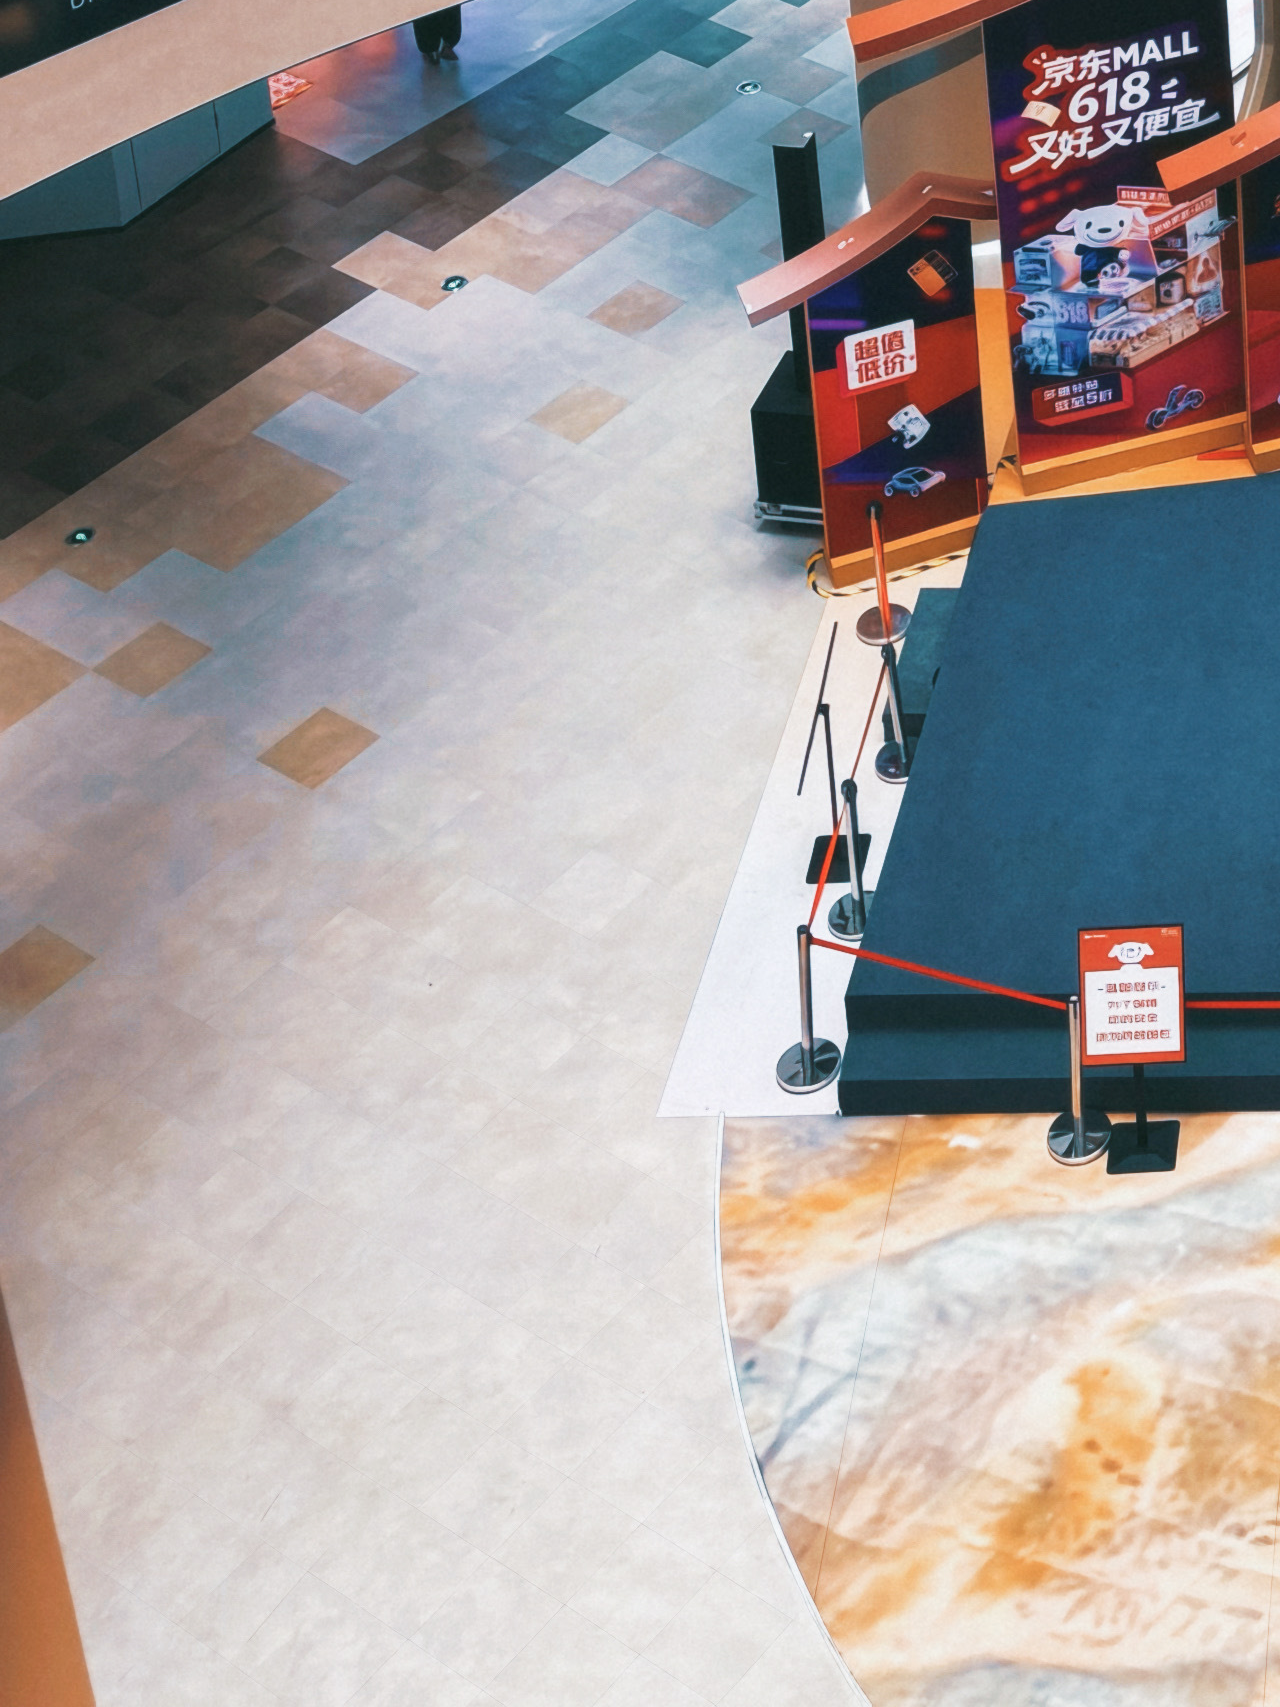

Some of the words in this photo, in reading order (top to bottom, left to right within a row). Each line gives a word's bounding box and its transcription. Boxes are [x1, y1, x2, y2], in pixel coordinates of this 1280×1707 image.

[1031, 31, 1200, 96] 京东MALL
[1067, 71, 1150, 124] 618
[1009, 98, 1221, 175] 又好又便宜
[854, 329, 907, 361] 超值
[854, 356, 907, 385] 低价
